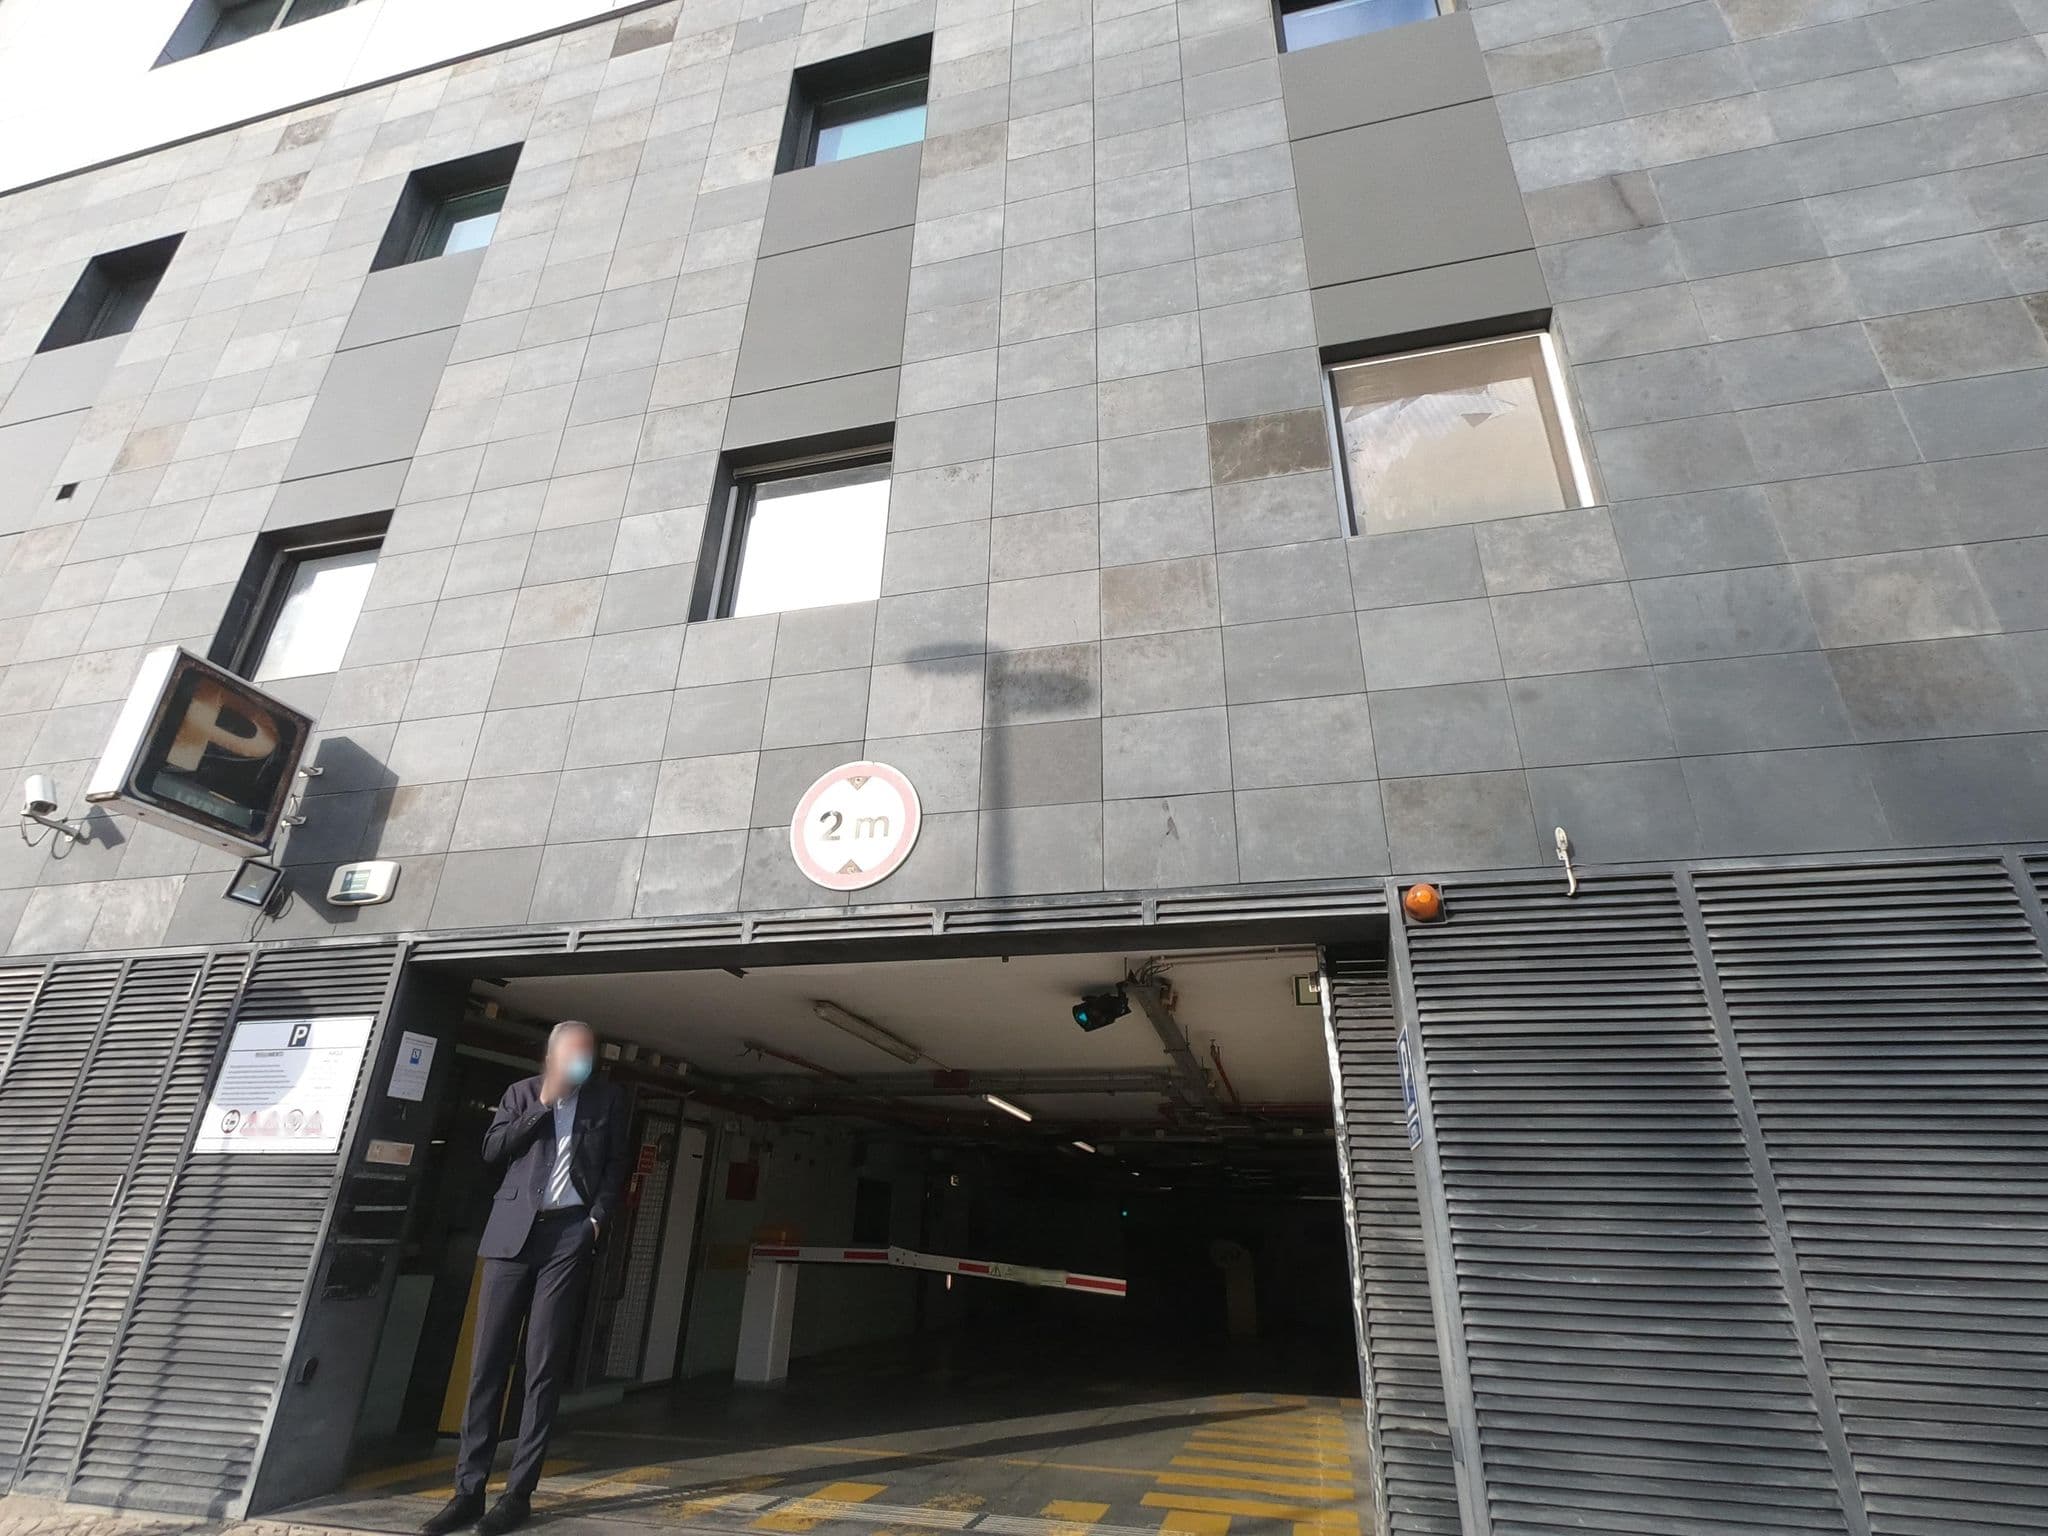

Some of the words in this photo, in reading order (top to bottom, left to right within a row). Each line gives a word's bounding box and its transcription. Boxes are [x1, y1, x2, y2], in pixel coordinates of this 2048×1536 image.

[166, 678, 281, 772] P
[819, 810, 843, 841] 2
[855, 815, 890, 840] m
[292, 1027, 309, 1045] P
